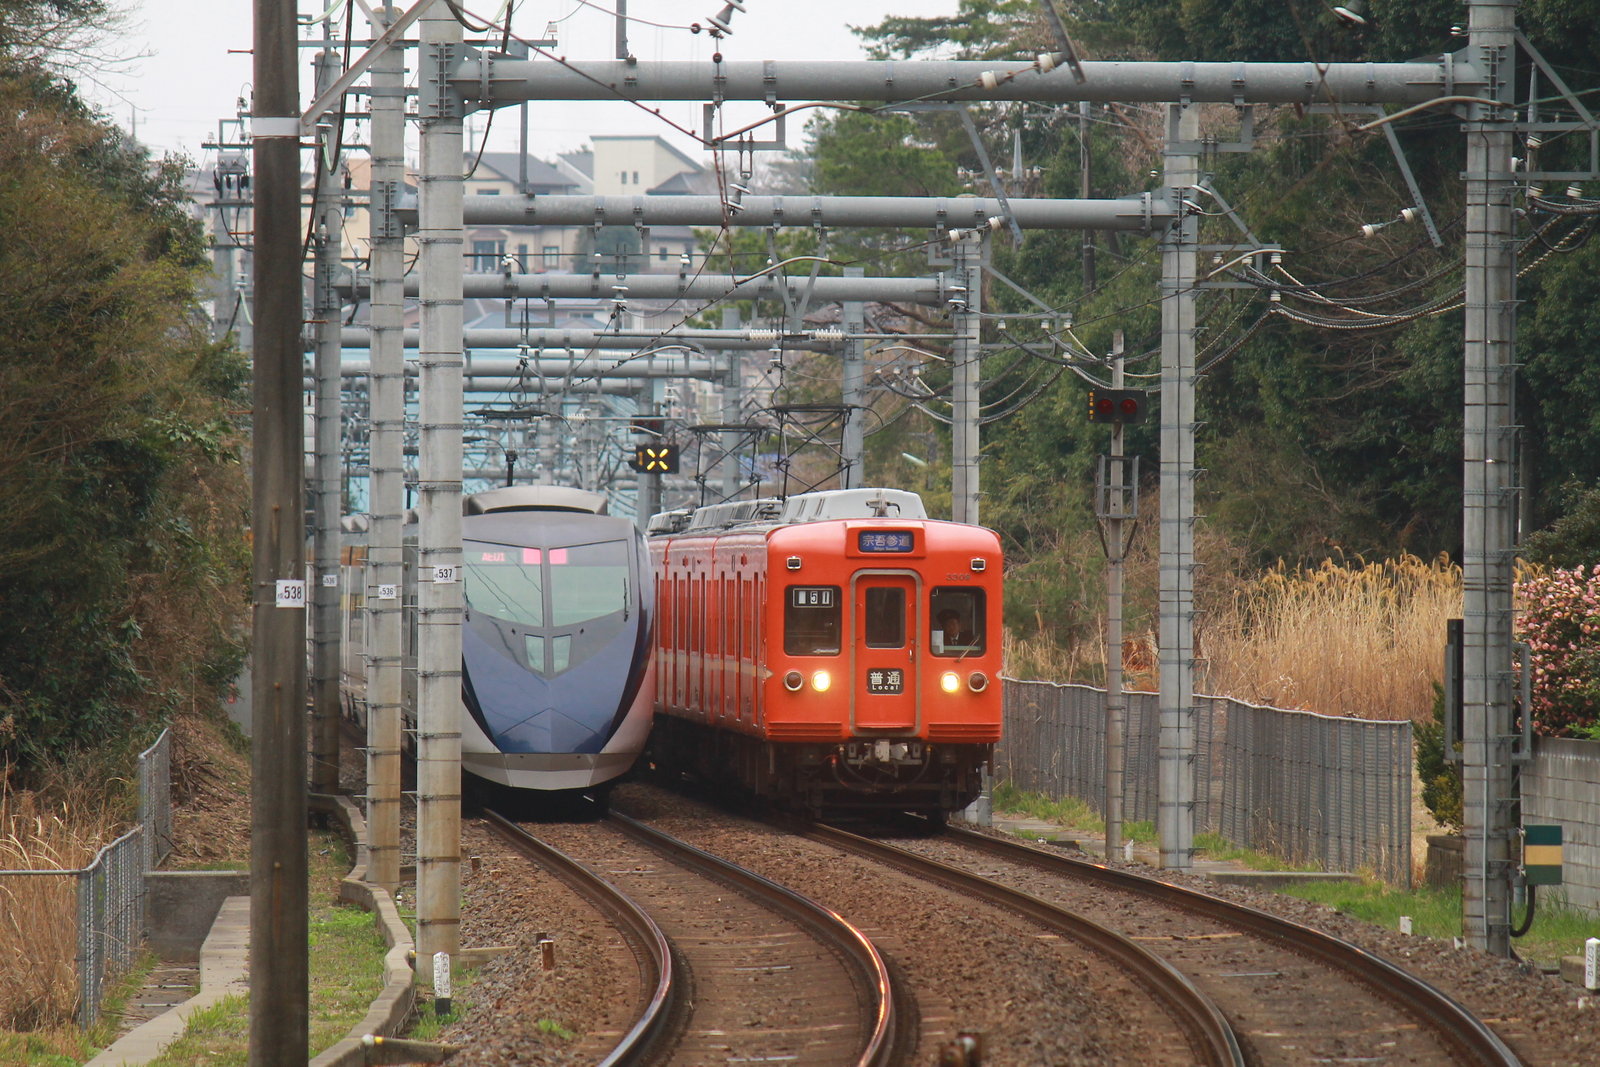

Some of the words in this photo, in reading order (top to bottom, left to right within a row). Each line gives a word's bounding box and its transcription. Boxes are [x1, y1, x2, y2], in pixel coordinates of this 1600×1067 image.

[863, 534, 910, 546] 宗吾参道
[438, 568, 452, 578] 537
[284, 585, 302, 599] 538
[382, 587, 393, 595] 536
[870, 671, 900, 684] 普通
